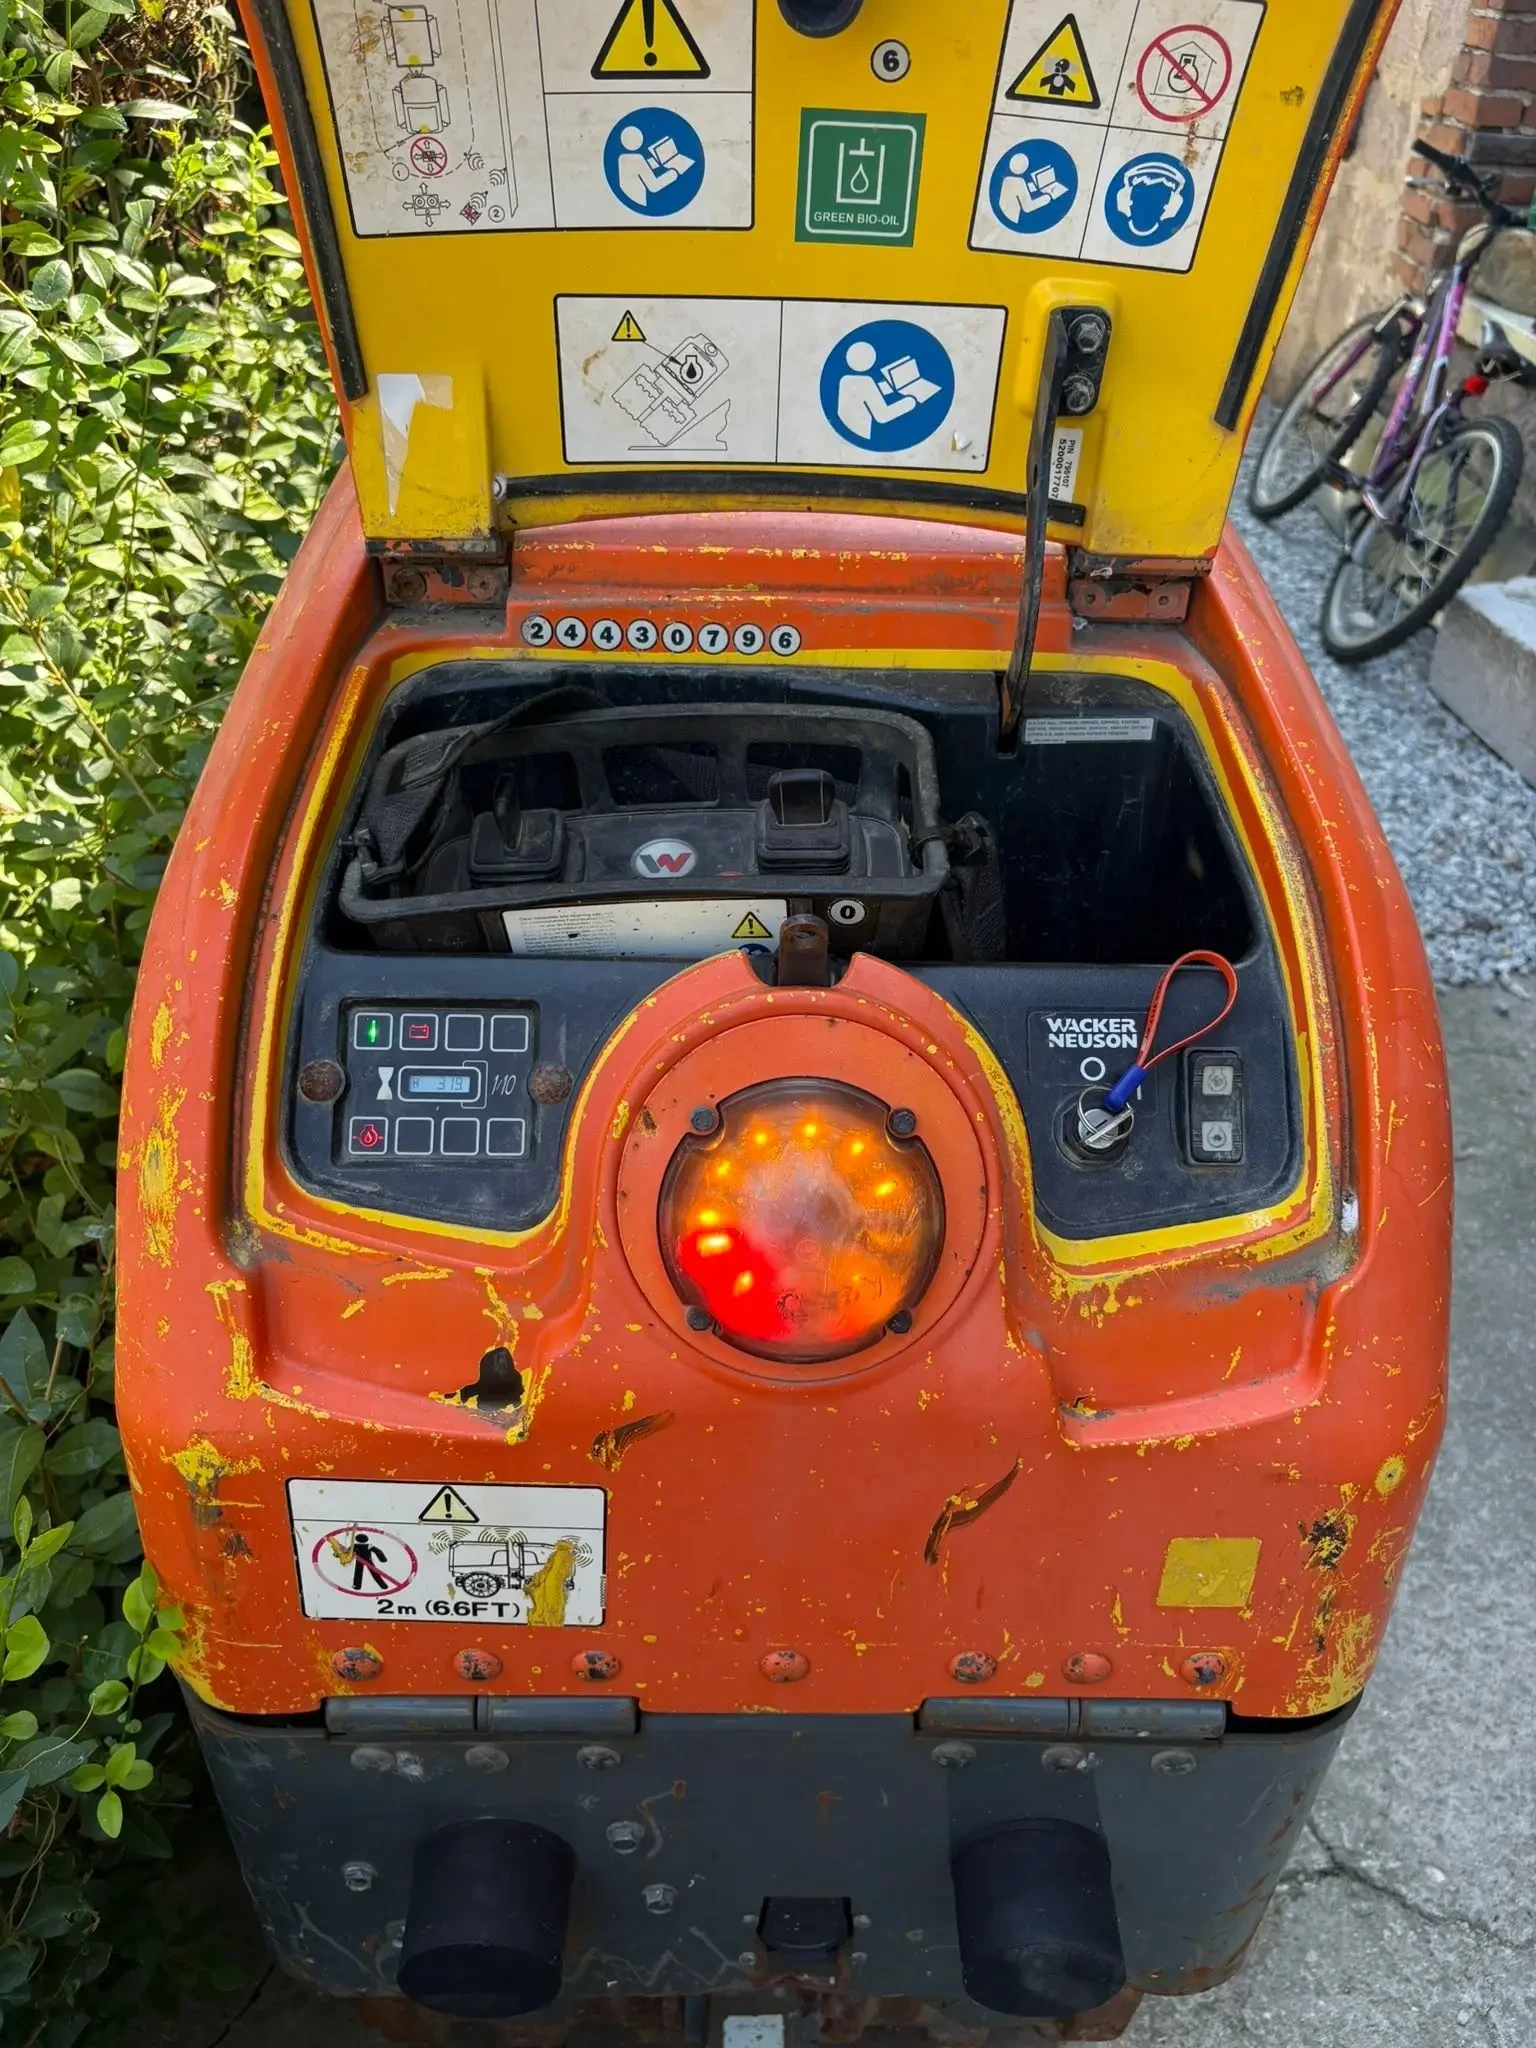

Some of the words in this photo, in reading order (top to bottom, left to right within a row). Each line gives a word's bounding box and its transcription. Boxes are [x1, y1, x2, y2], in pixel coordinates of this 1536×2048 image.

[882, 49, 900, 73] 6
[813, 211, 854, 224] GREEN
[857, 213, 900, 226] BIO-OIL
[1066, 439, 1076, 454] PIN
[1047, 1017, 1138, 1033] WACKER
[1048, 1033, 1138, 1049] NEUSON
[425, 1599, 520, 1618] (6.6FT)
